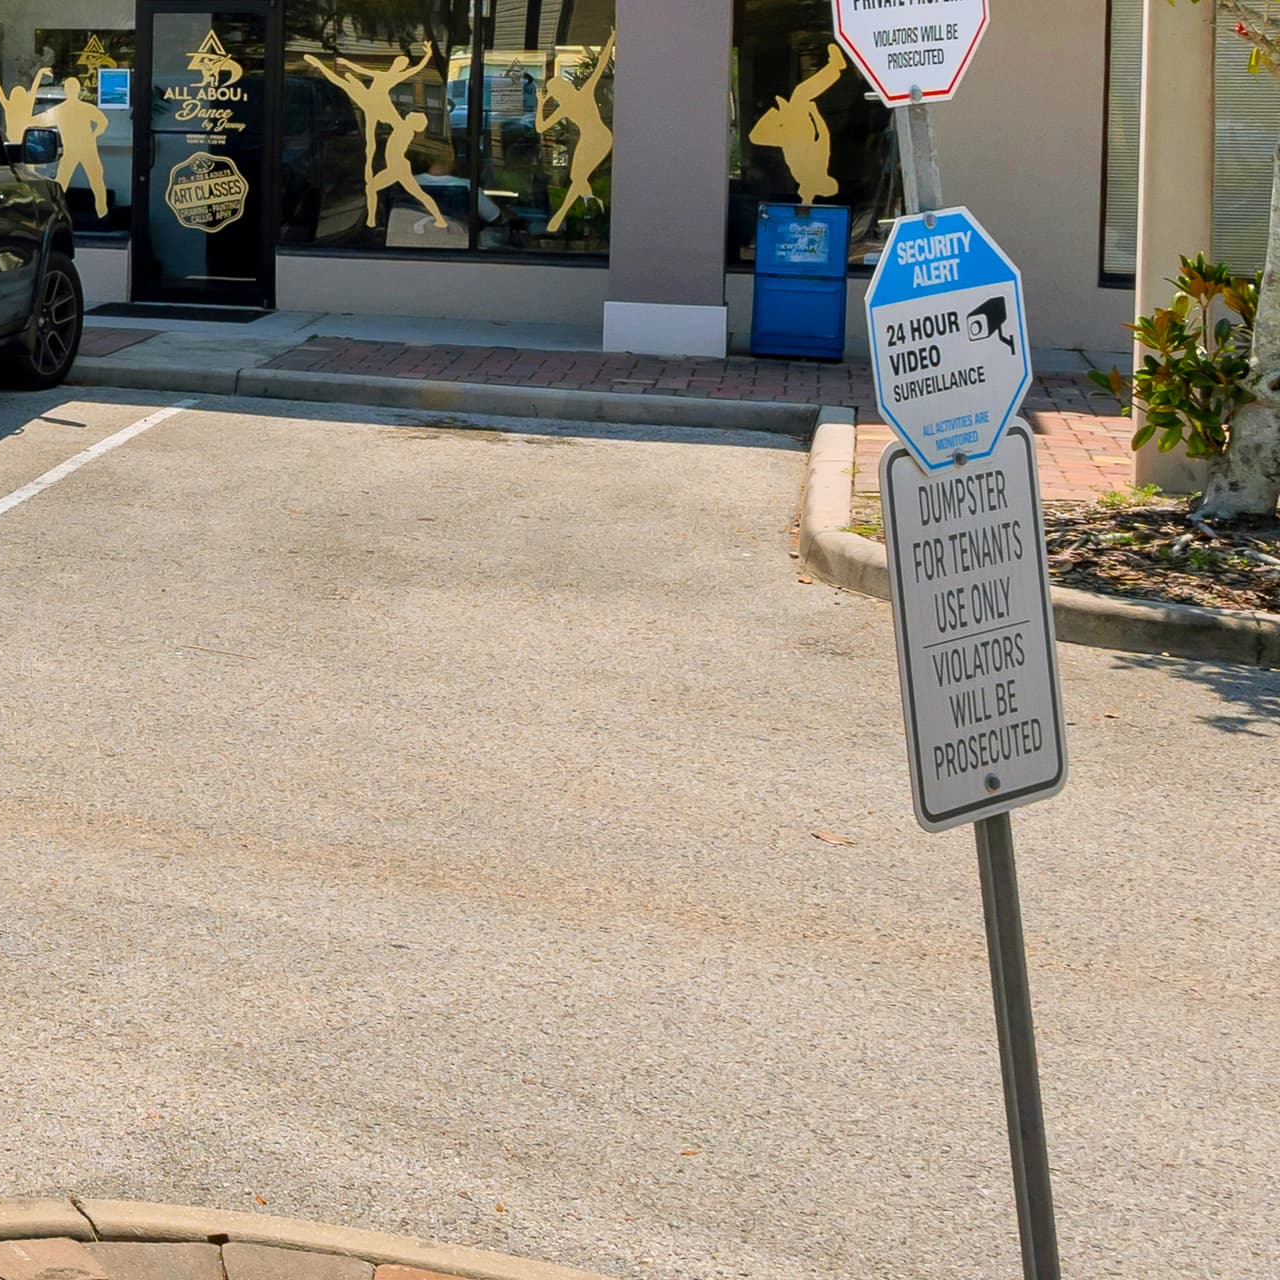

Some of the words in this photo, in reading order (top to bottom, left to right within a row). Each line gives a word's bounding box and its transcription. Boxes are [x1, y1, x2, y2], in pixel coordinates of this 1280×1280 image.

[873, 27, 918, 48] VIOLATORS
[920, 25, 944, 43] WILL
[946, 23, 959, 40] BE
[887, 48, 944, 70] PROSECUTED
[163, 86, 193, 100] ALL
[175, 99, 234, 121] Dance
[174, 186, 194, 205] ART
[195, 179, 241, 200] CLASSES
[897, 230, 972, 266] SECURITY
[913, 258, 960, 289] ALERT
[887, 323, 906, 347] 24
[910, 311, 960, 343] HOUR
[889, 345, 941, 377] VIDEO
[893, 366, 986, 403] SURVEILLANCE
[922, 422, 936, 437] ALL
[936, 415, 973, 435] ACTIVITIES
[974, 411, 990, 426] ARE
[936, 431, 979, 451] MONITORED
[918, 469, 1007, 527] DUMPSTER
[913, 537, 947, 584] FOR
[948, 521, 1024, 573] TENANTS
[934, 587, 968, 633] USE
[971, 576, 1012, 624] ONLY
[932, 632, 1026, 688] VIOLATORS
[949, 688, 992, 729] WILL
[995, 679, 1018, 715] BE
[933, 718, 1043, 781] PROSECUTED
